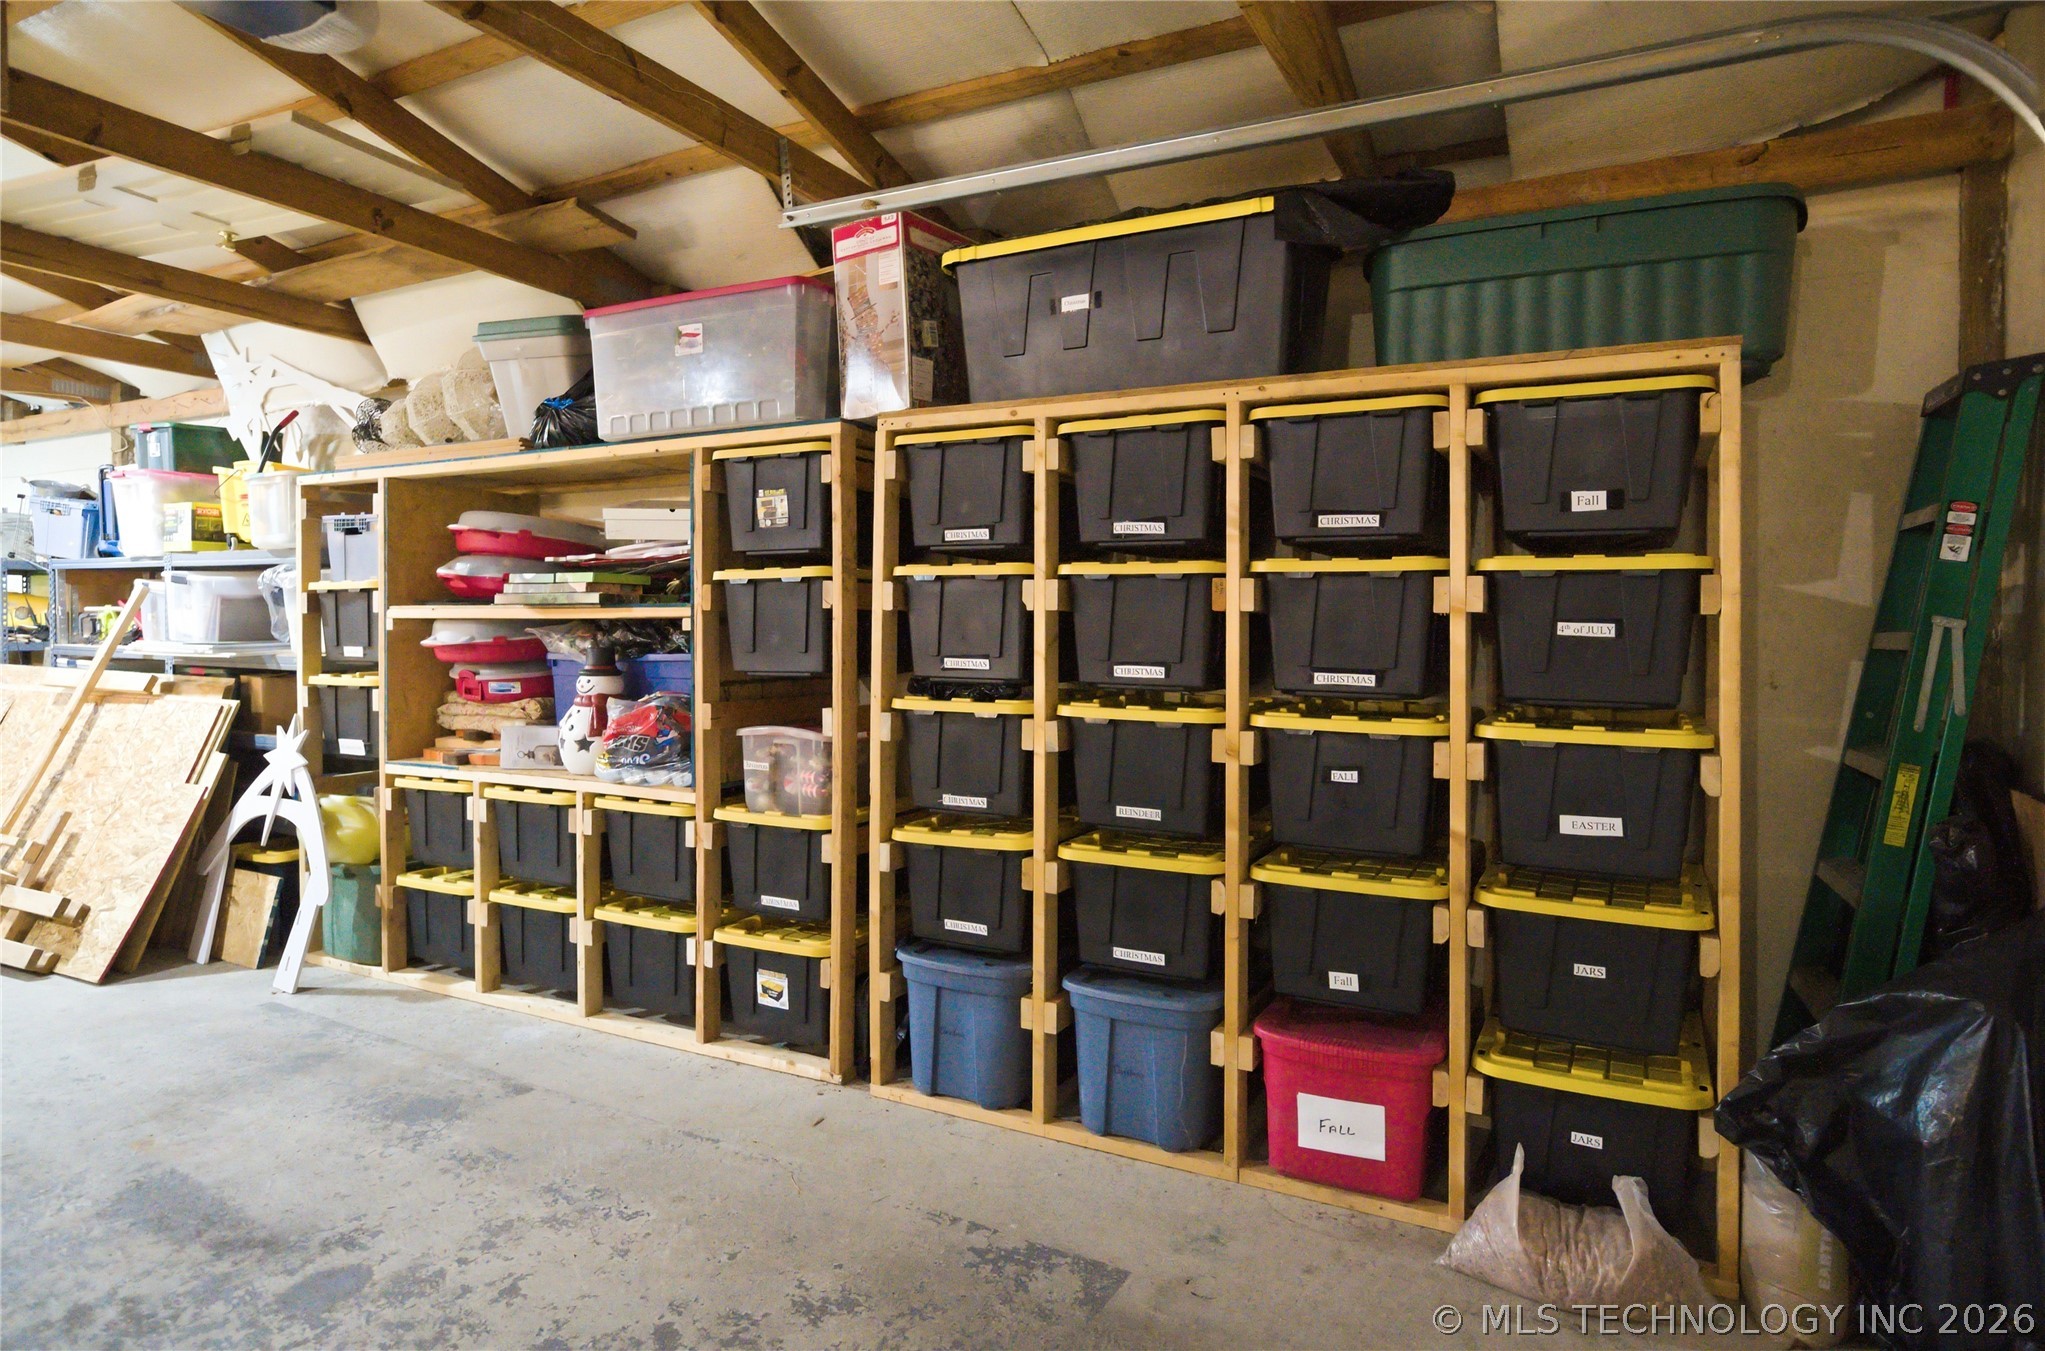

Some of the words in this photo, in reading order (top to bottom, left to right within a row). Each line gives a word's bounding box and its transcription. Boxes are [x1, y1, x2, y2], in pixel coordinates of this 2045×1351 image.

[1577, 496, 1599, 506] Fall
[1320, 516, 1377, 525] CHRISTMAS
[1114, 524, 1163, 532] CHRISTMAS
[945, 530, 987, 539] CHRISTMAS
[1559, 624, 1571, 633] 4th
[1573, 625, 1585, 635] of
[1586, 626, 1614, 636] JULY
[945, 660, 987, 668] CHRISTMAS
[1115, 668, 1163, 677] CHRISTMAS
[1316, 674, 1373, 685] CHRISTMAS
[1332, 772, 1357, 781] FALL
[943, 796, 985, 806] CHRISTMAS
[1119, 808, 1161, 819] REINDEER
[1571, 820, 1616, 832] EASTER
[945, 921, 987, 933] CHRISTMAS
[1114, 949, 1163, 963] CHRISTMAS
[1575, 966, 1604, 977] JARS
[1334, 976, 1353, 986] Fall
[1319, 1118, 1356, 1135] FALL
[1572, 1134, 1601, 1147] JARS
